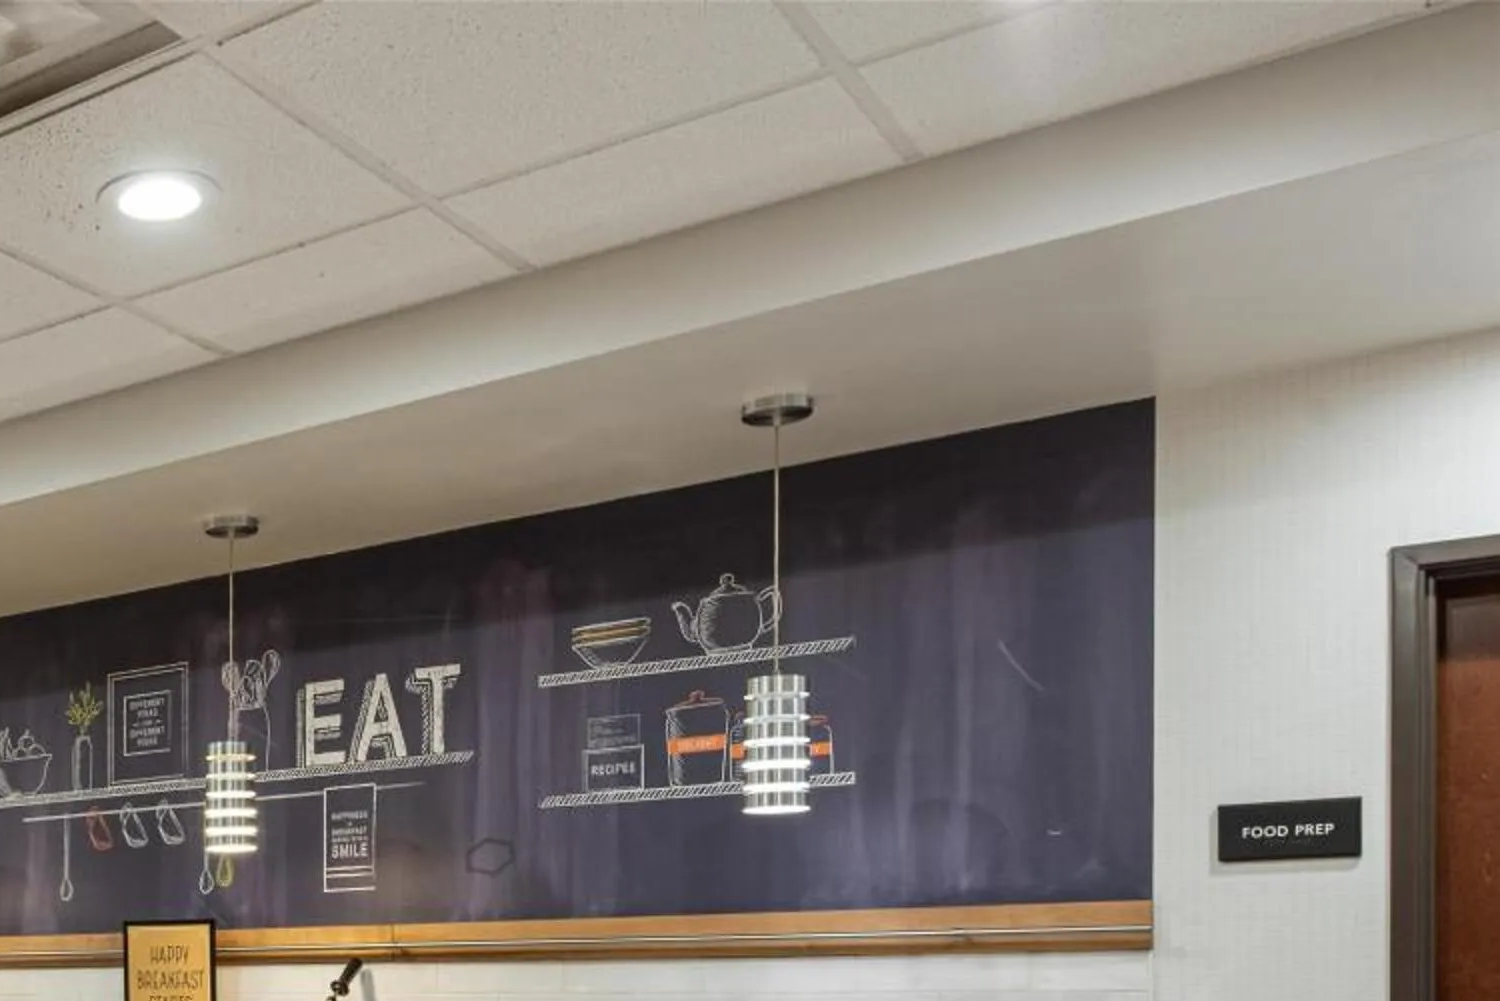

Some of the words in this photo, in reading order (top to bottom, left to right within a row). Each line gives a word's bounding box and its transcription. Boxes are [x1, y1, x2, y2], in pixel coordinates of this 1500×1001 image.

[297, 663, 462, 768] EAT
[1241, 825, 1289, 839] FOOD
[1295, 823, 1335, 837] PREP
[331, 842, 369, 859] SMILE
[150, 944, 190, 964] HAPPY
[137, 969, 205, 991] BREAKFAST
